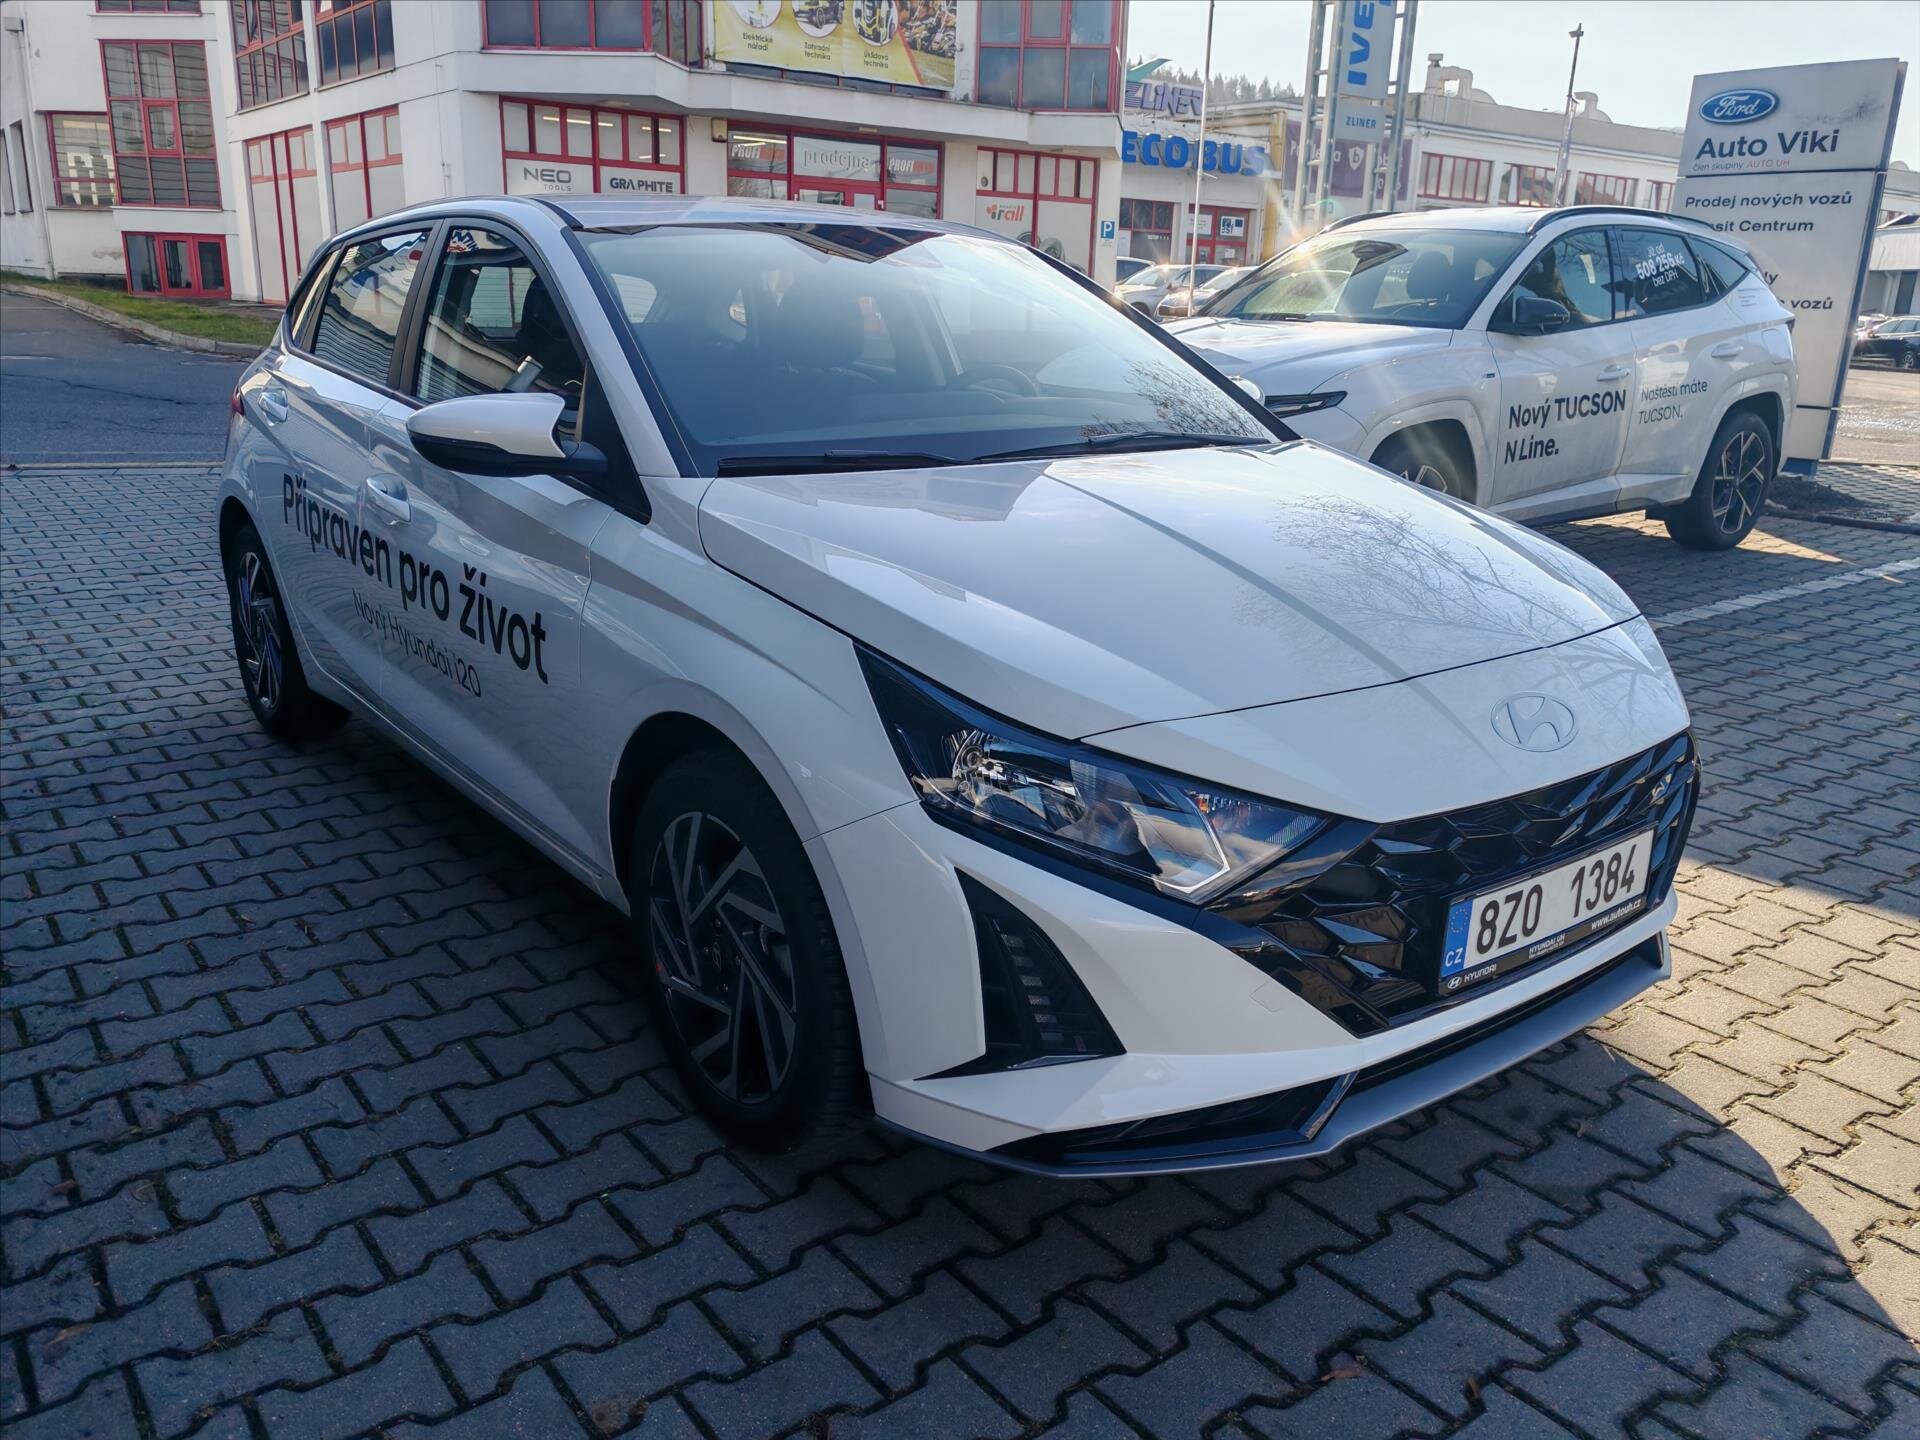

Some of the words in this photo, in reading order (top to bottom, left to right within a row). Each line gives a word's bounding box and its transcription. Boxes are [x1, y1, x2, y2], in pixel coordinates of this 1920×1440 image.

[804, 51, 831, 61] technika
[864, 59, 889, 69] technika
[1713, 95, 1761, 118] Ford
[1345, 116, 1377, 129] ZLINER
[1695, 136, 1768, 160] Auto
[1777, 128, 1840, 154] Viki
[1746, 159, 1773, 168] AUTO
[523, 167, 572, 184] NEO
[544, 183, 572, 191] TOOLS
[1685, 195, 1736, 209] Prodej
[1740, 193, 1803, 208] nových
[1808, 191, 1852, 205] vozů
[1739, 220, 1814, 232] Centrum
[1635, 259, 1657, 279] 508
[1656, 253, 1675, 272] 256
[1652, 275, 1665, 287] bez
[1664, 268, 1679, 282] DPH
[1790, 296, 1833, 310] vozů
[1679, 378, 1708, 395] máte
[1508, 398, 1551, 429] Nový
[1554, 389, 1627, 421] TUCSON
[1639, 404, 1683, 425] TUCSON.
[283, 473, 392, 589] Připraven
[400, 549, 450, 621] pro
[459, 562, 549, 685] život
[352, 588, 387, 640] Nový
[388, 612, 453, 680] Hyundai
[453, 652, 481, 698] i20
[1476, 884, 1543, 955] 8Z0
[1570, 843, 1637, 918] 1384
[1445, 947, 1463, 967] CZ
[1464, 963, 1497, 983] HYUNDAI
